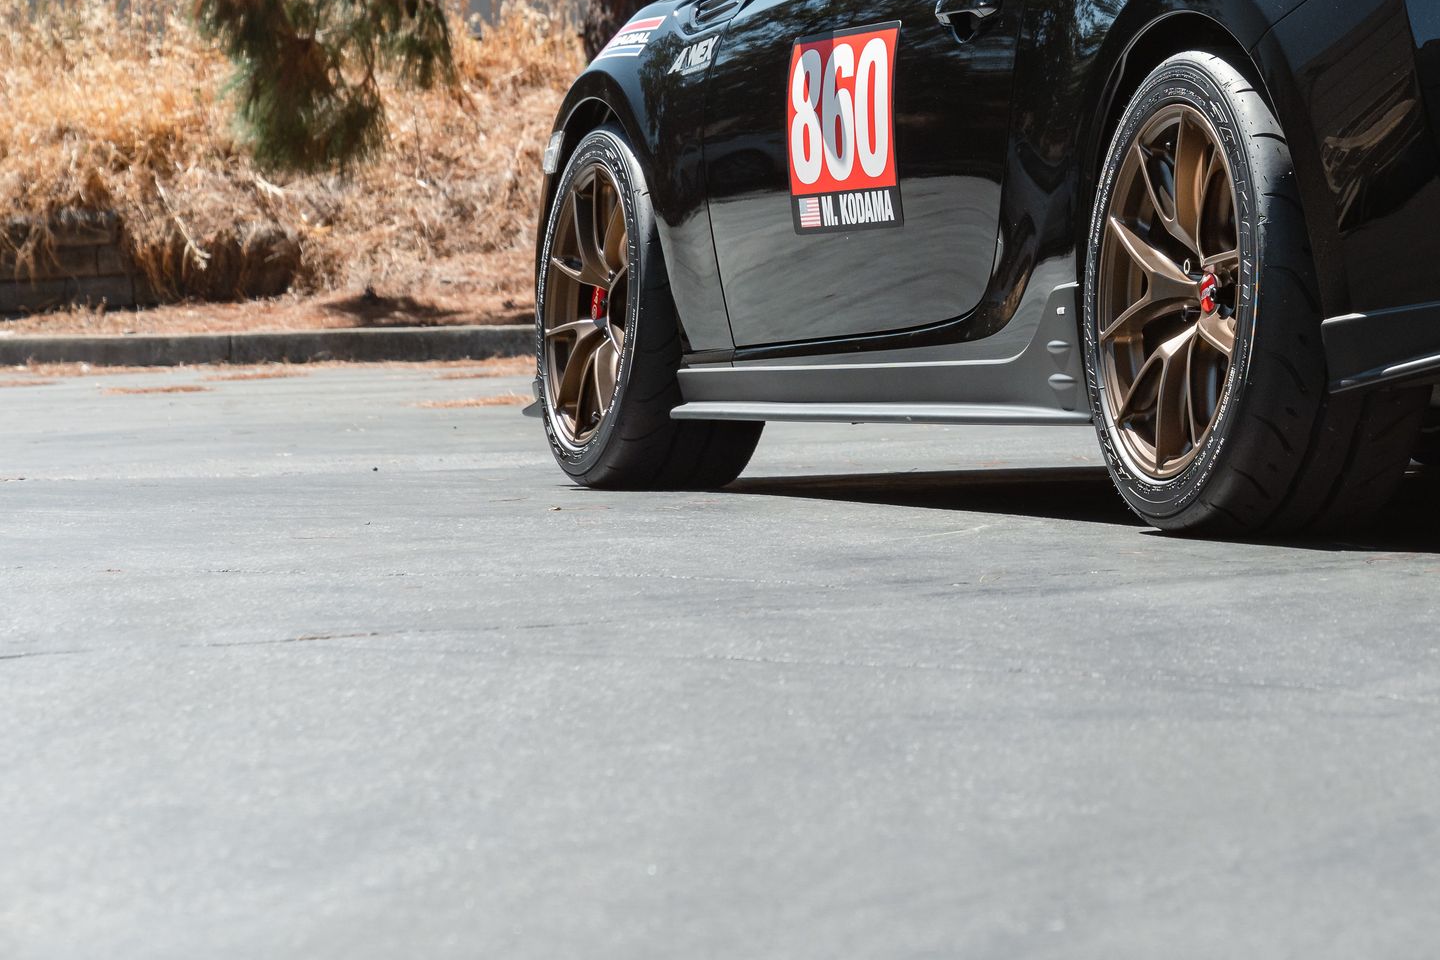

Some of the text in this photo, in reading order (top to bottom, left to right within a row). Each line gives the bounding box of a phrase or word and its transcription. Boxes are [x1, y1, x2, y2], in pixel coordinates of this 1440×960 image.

[791, 37, 889, 185] 860
[821, 189, 895, 227] M. KODAMA
